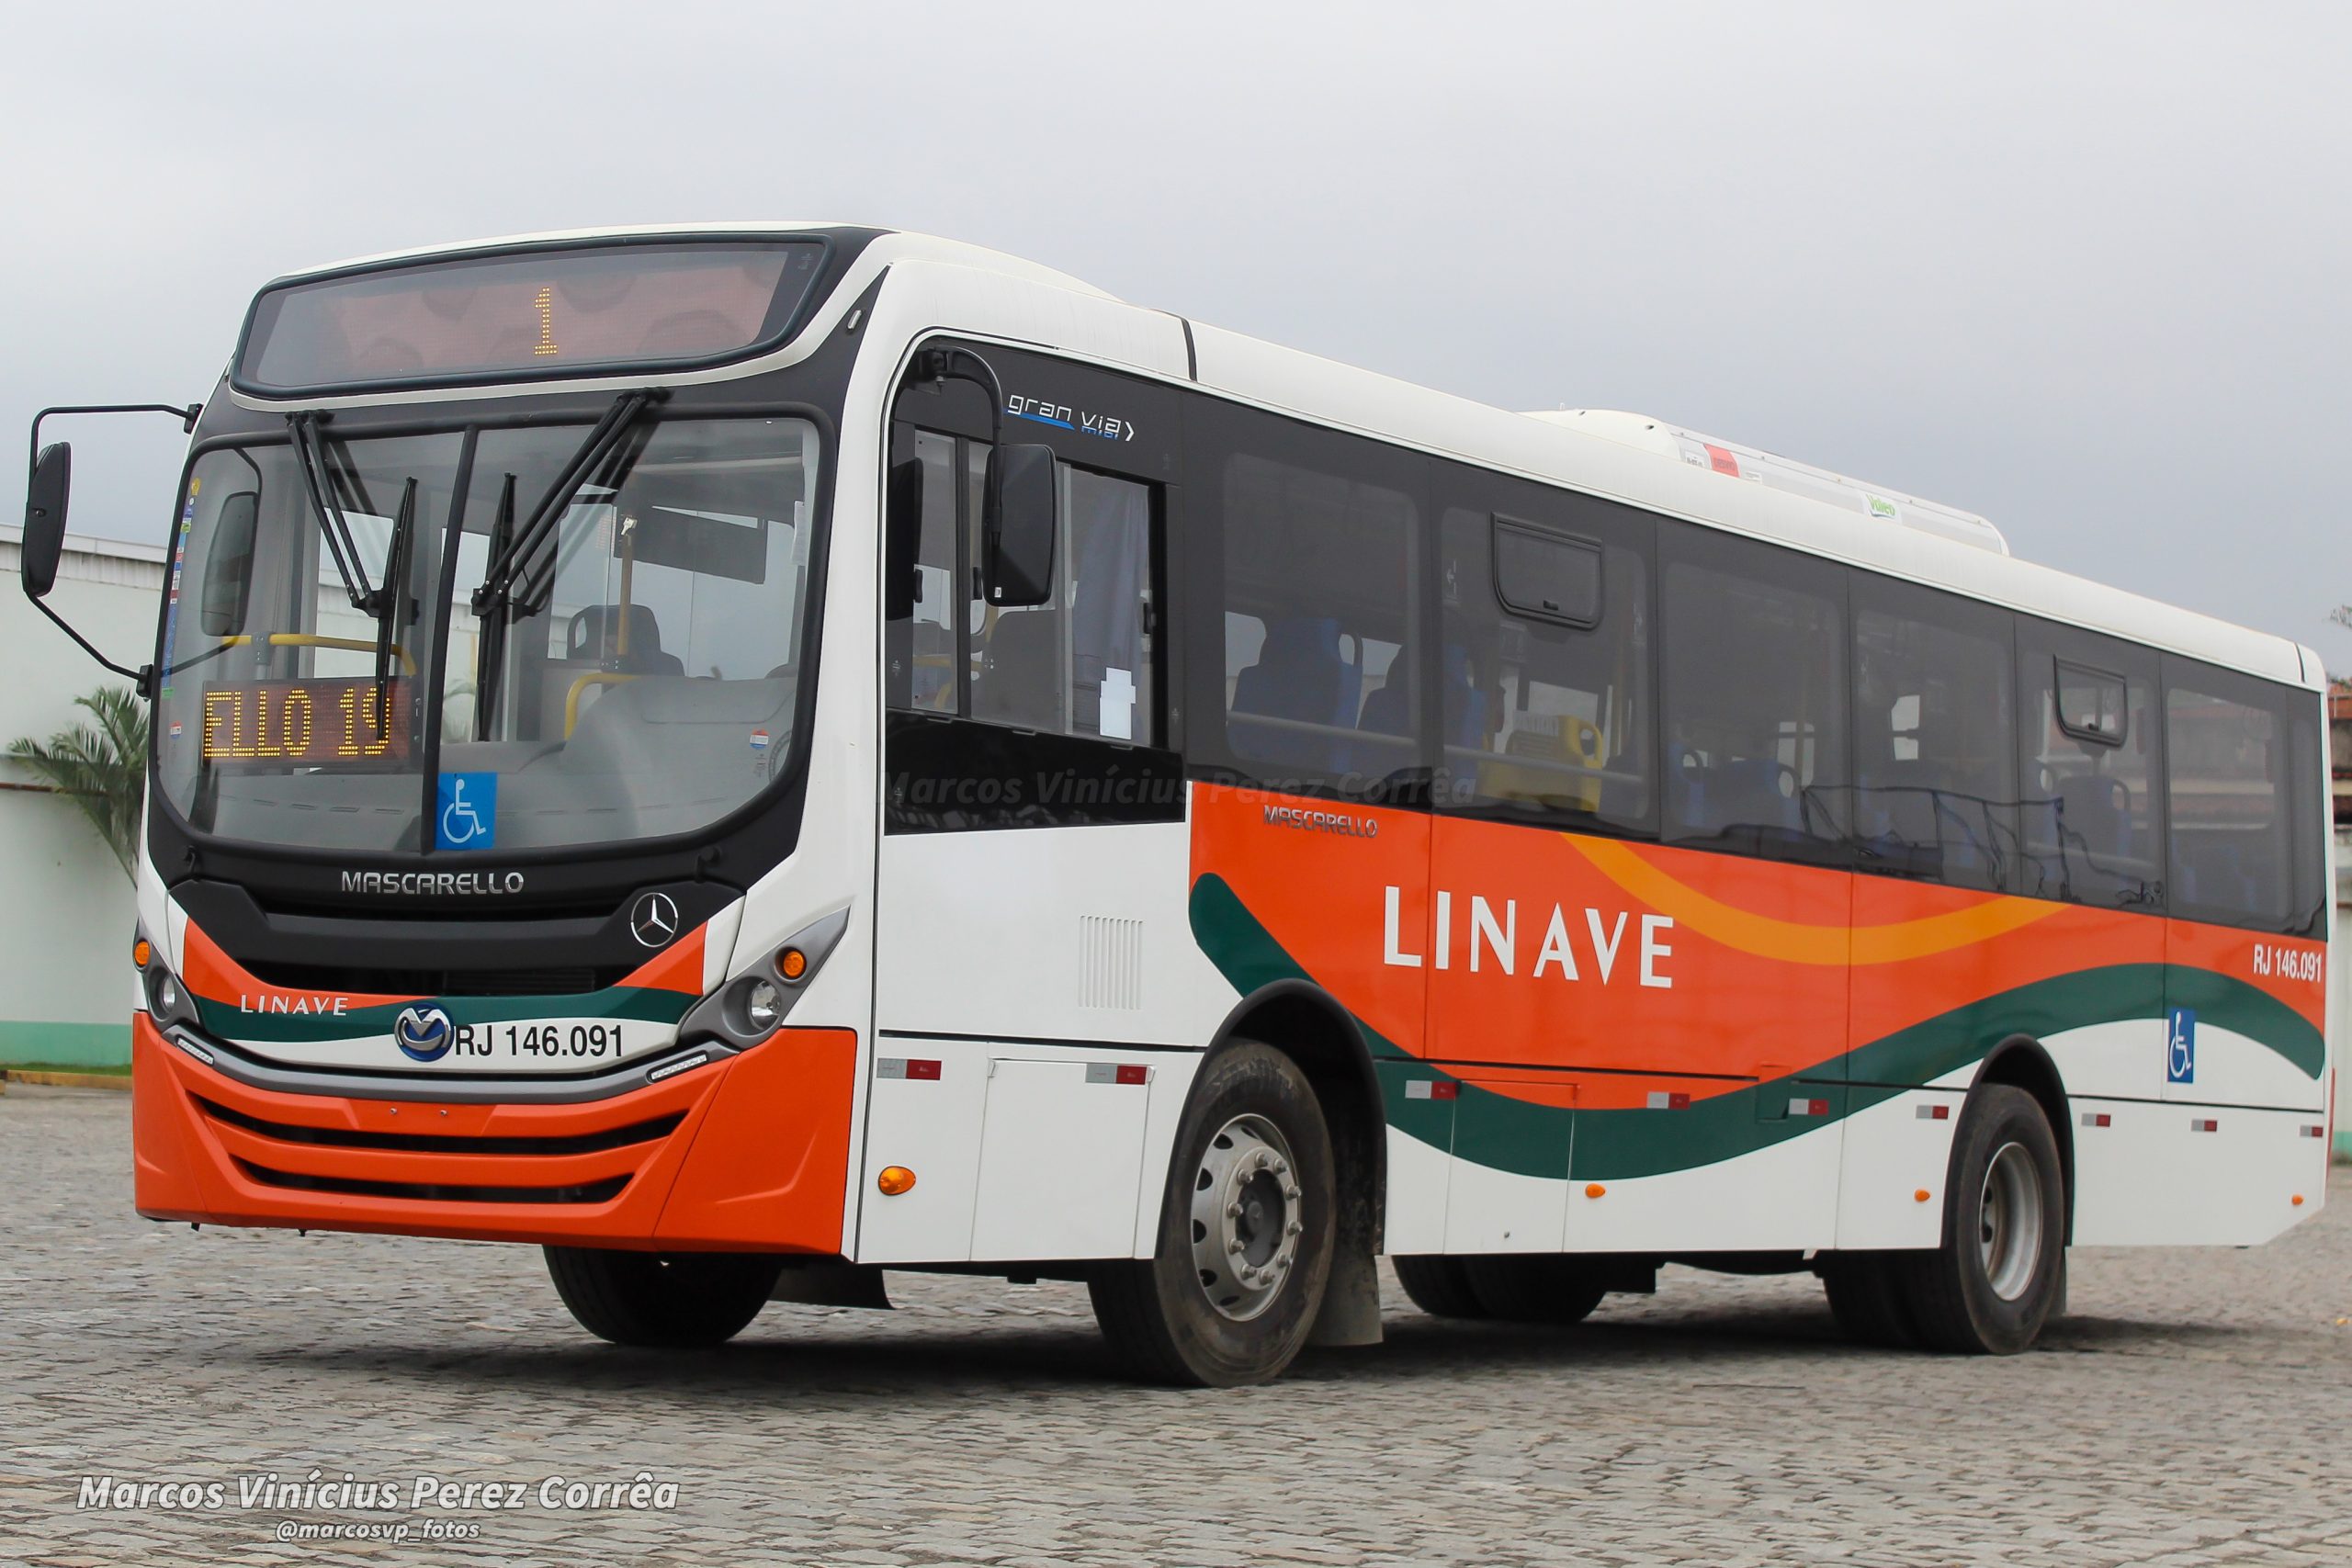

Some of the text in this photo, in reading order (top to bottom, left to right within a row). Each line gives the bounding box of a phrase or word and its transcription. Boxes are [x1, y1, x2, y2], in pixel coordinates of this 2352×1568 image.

[534, 287, 558, 355] 1
[1007, 394, 1122, 434] gran via
[204, 687, 390, 757] ELLO 19
[1263, 804, 1377, 838] MASCARELLO
[341, 871, 525, 895] MASCARELLO
[1384, 886, 1674, 988] LINAVE
[2253, 943, 2323, 983] RJ 146.091
[240, 994, 349, 1017] LINAVE
[454, 1024, 624, 1057] RJ 146.091
